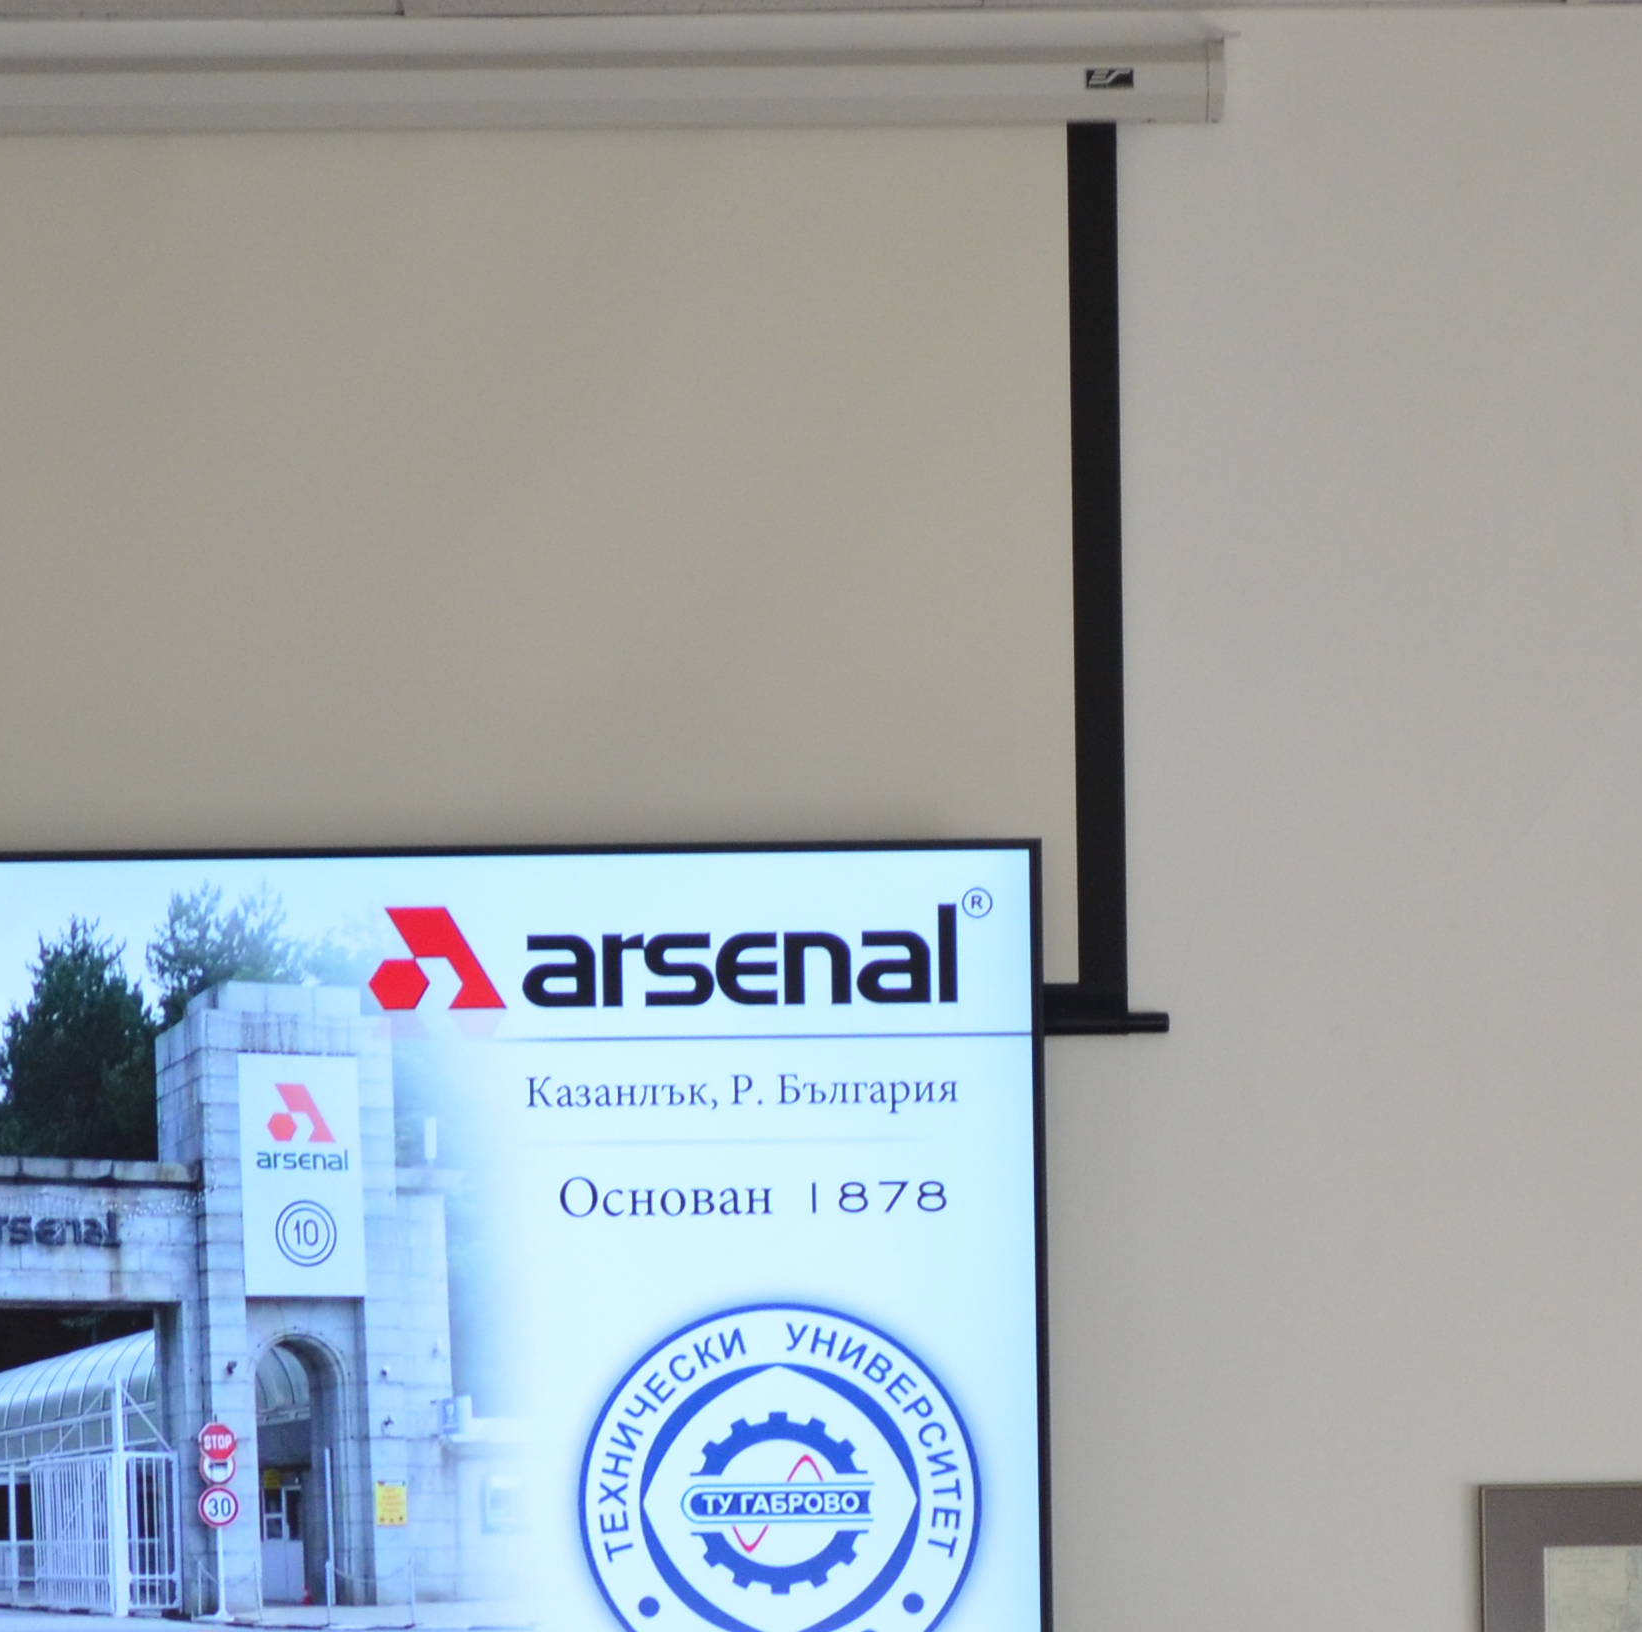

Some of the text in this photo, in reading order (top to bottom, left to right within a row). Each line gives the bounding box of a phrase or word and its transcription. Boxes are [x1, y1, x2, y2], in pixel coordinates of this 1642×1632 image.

[522, 903, 958, 1009] arsenal
[524, 1072, 959, 1115] Казанлък, Р. България
[256, 1149, 348, 1171] arsenal
[558, 1175, 948, 1218] Основан 1878
[293, 1219, 319, 1247] 10
[203, 1433, 233, 1451] STOP
[598, 1322, 962, 1563] ТЕХНИЧЕСКИ УНИВЕРСИТЕТ
[208, 1497, 232, 1518] 30
[702, 1491, 861, 1514] ТУ ГАБРОВО
